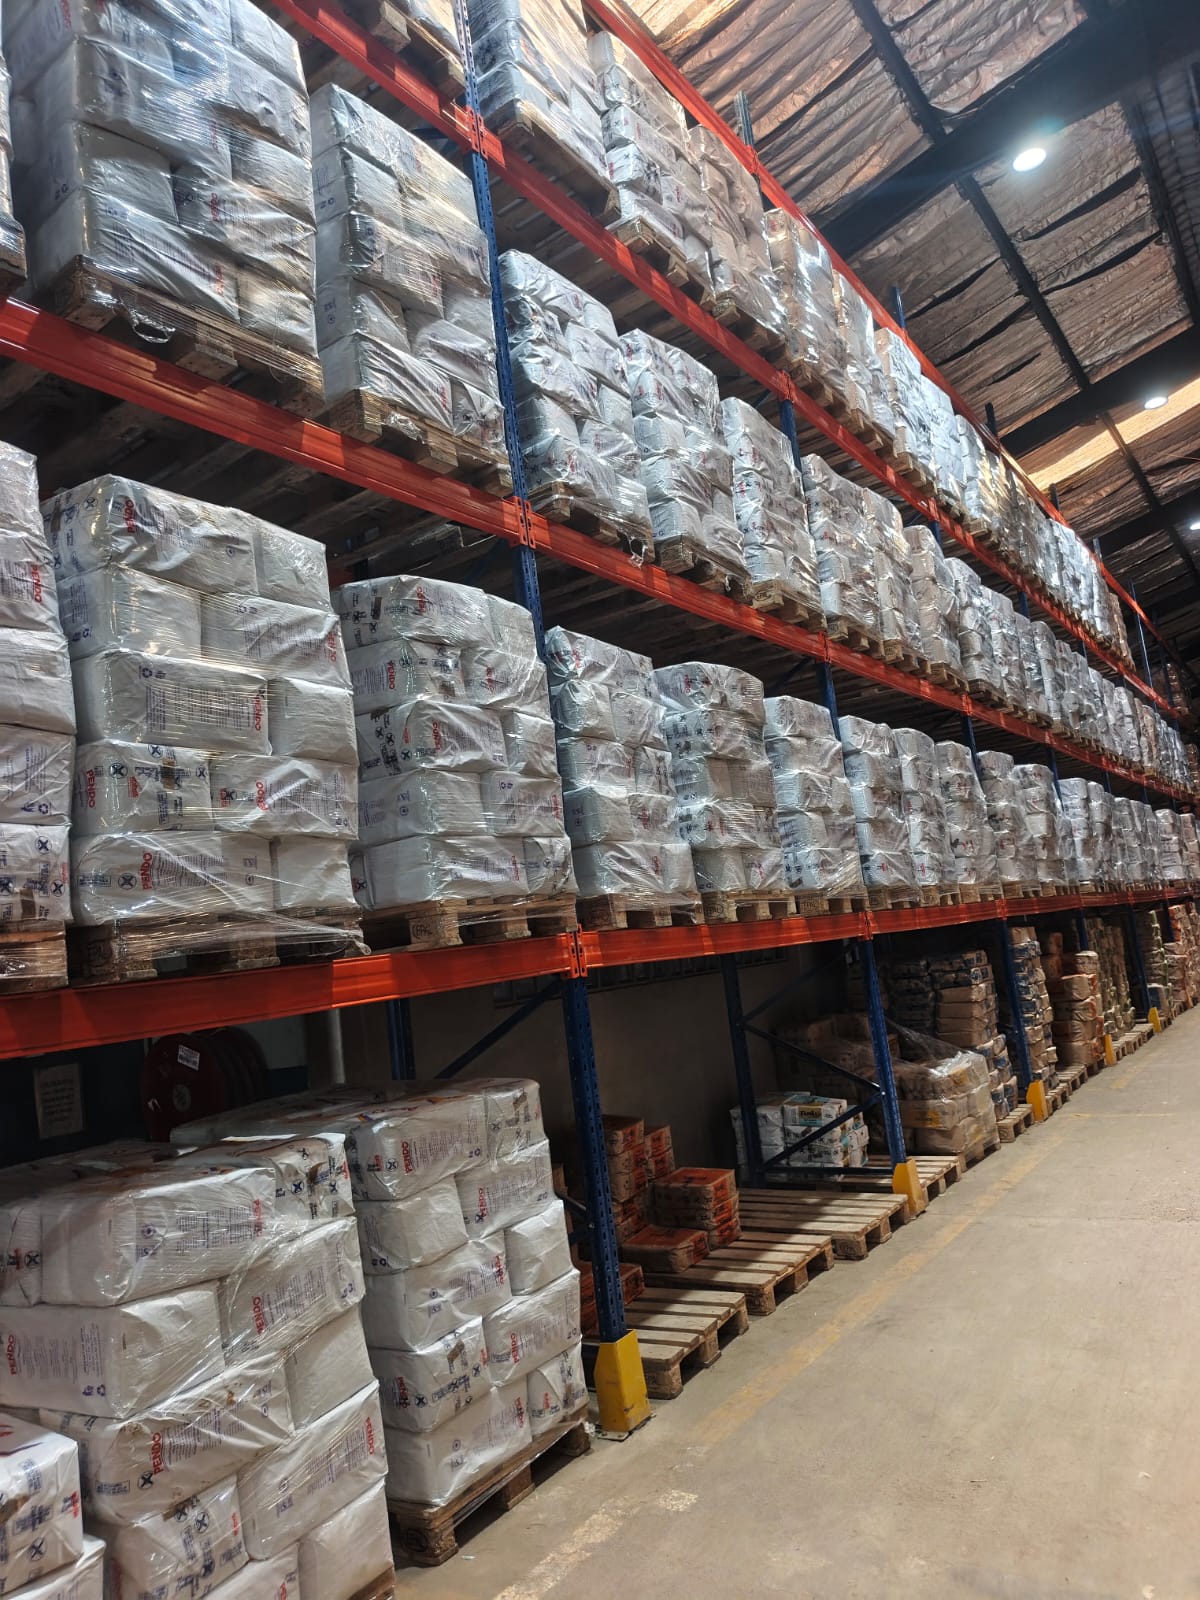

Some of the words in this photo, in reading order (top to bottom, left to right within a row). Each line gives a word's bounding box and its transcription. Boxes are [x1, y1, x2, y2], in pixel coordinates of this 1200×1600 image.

[123, 498, 136, 533] PENDO
[31, 565, 43, 603] PENDO
[387, 661, 396, 690] PENDO
[86, 769, 96, 808] PENDO
[140, 852, 152, 890] PENDO
[402, 1141, 413, 1175] PENDO
[252, 1297, 265, 1335] PENDO
[7, 1335, 16, 1375] PENDO
[510, 1332, 519, 1363] PENDO
[152, 1432, 164, 1475] PENDO
[366, 1417, 374, 1455] PENDO
